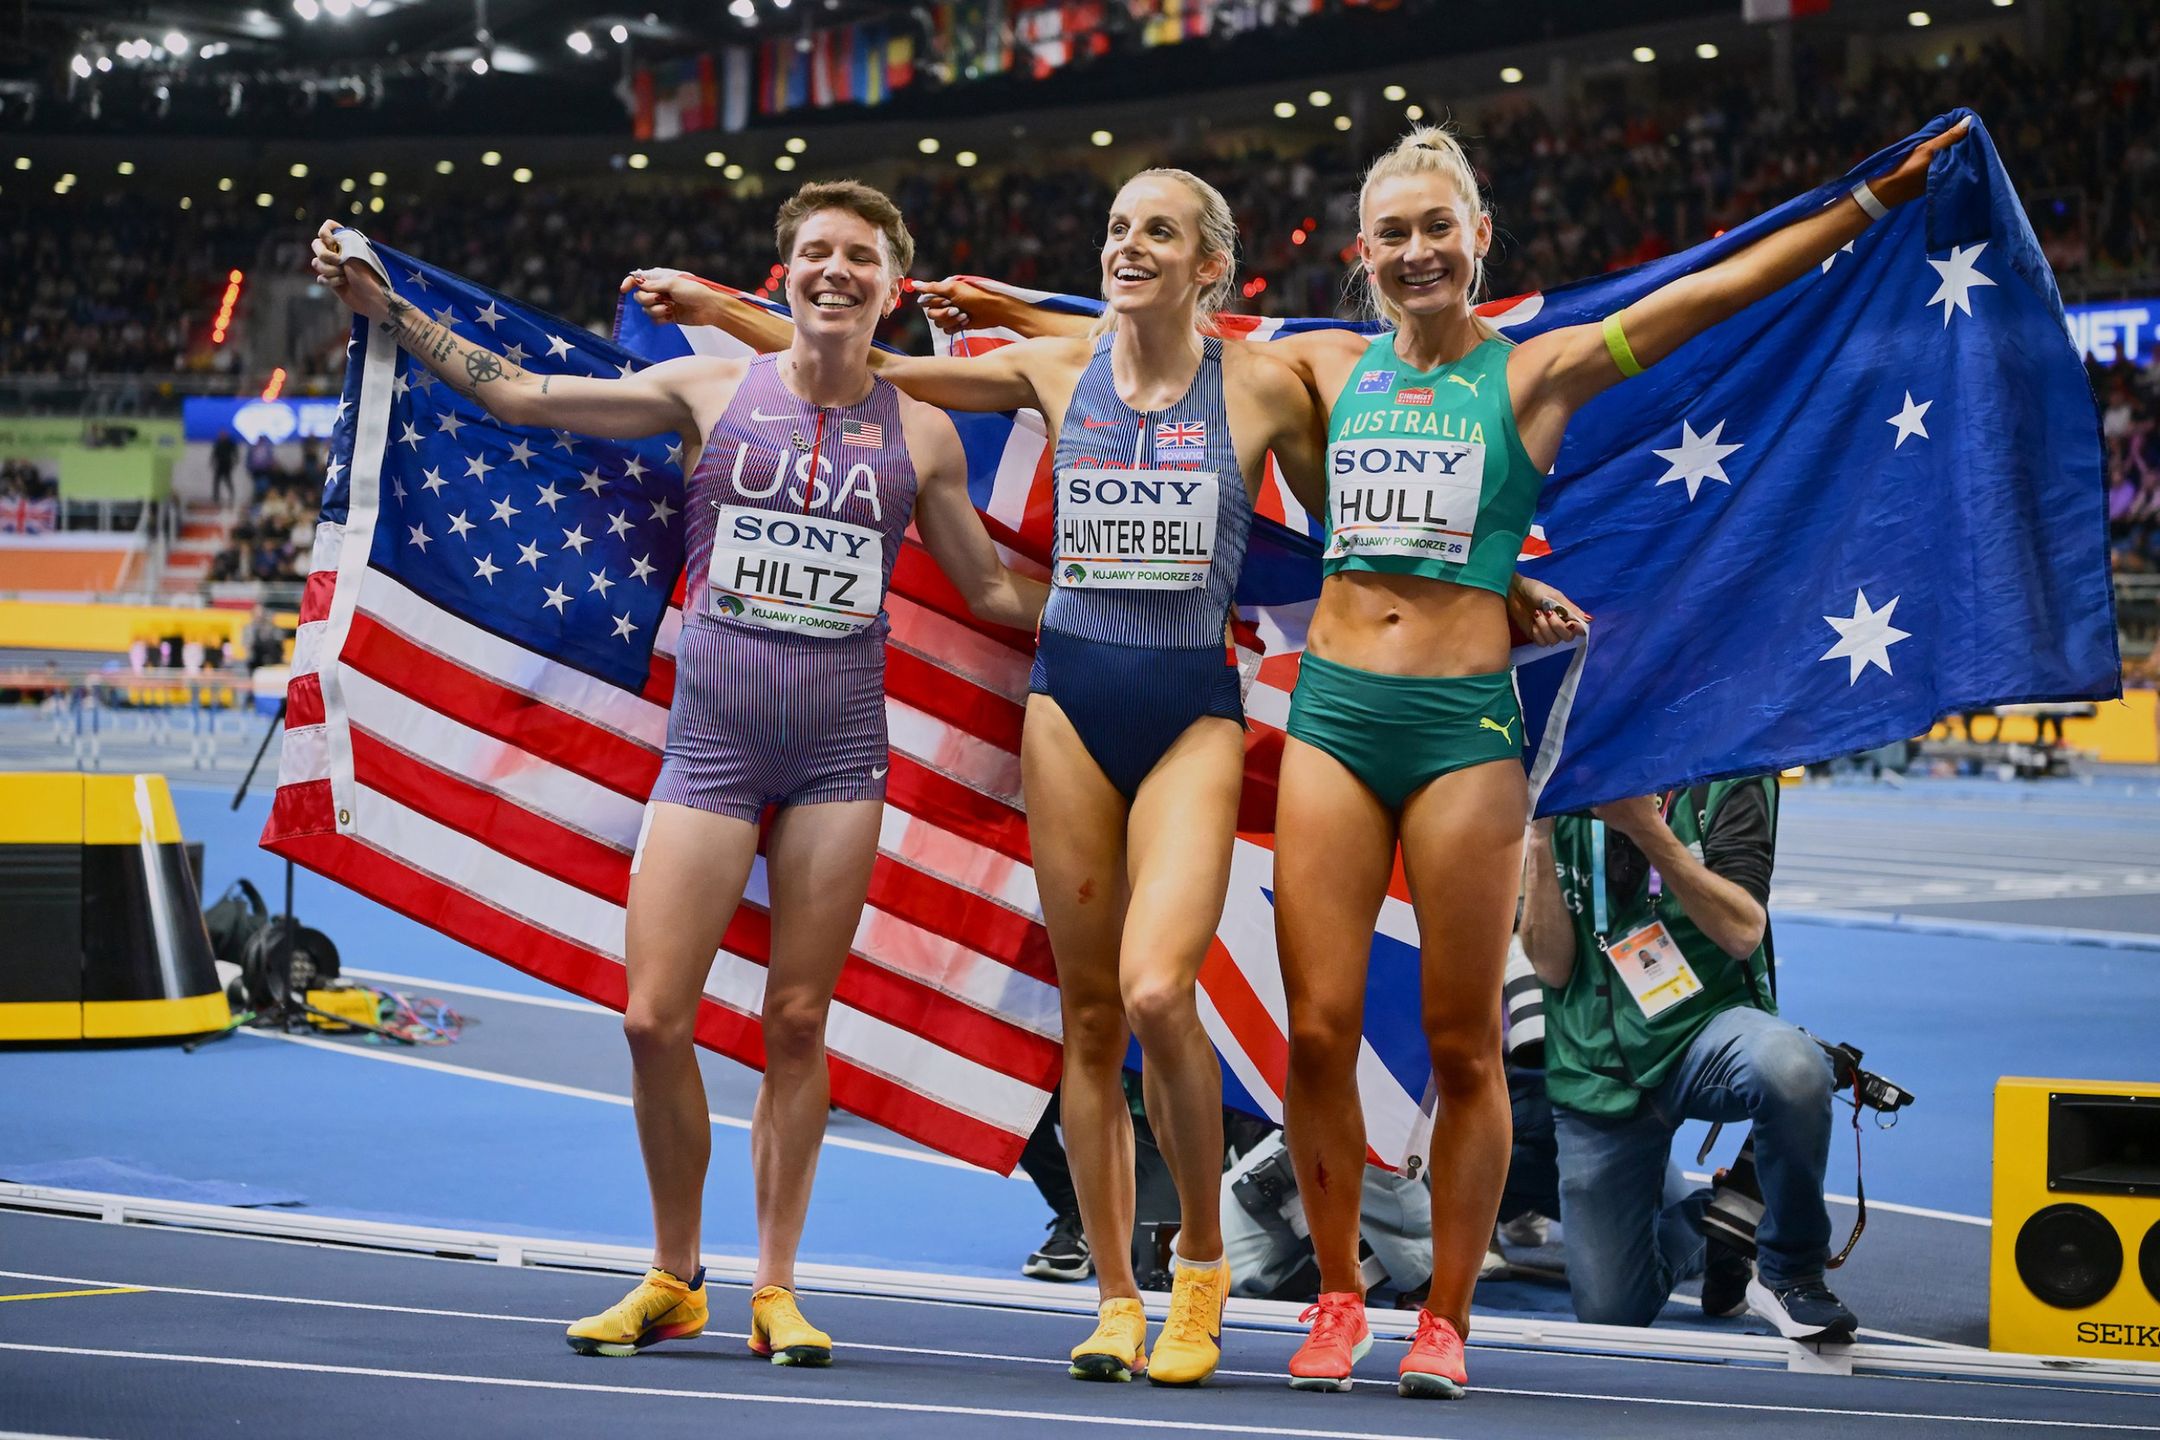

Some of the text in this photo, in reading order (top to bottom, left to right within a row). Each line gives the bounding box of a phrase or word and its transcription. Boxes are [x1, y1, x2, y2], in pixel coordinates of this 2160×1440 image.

[1338, 410, 1485, 444] AUSTRALIA
[1334, 448, 1467, 475] SONY
[732, 442, 882, 521] USA
[1069, 479, 1202, 505] SONY
[1340, 489, 1447, 525] HULL
[733, 515, 870, 559] SONY
[1063, 519, 1208, 556] HUNTER BELL
[1393, 537, 1447, 551] POMORZE
[1448, 543, 1462, 554] 26
[734, 556, 858, 607] HILTZ
[1092, 570, 1204, 582] KUJAWY POMORZE 26
[751, 607, 797, 623] KUJAWY
[799, 615, 851, 632] POMORZE
[2077, 1321, 2160, 1347] SEIK
